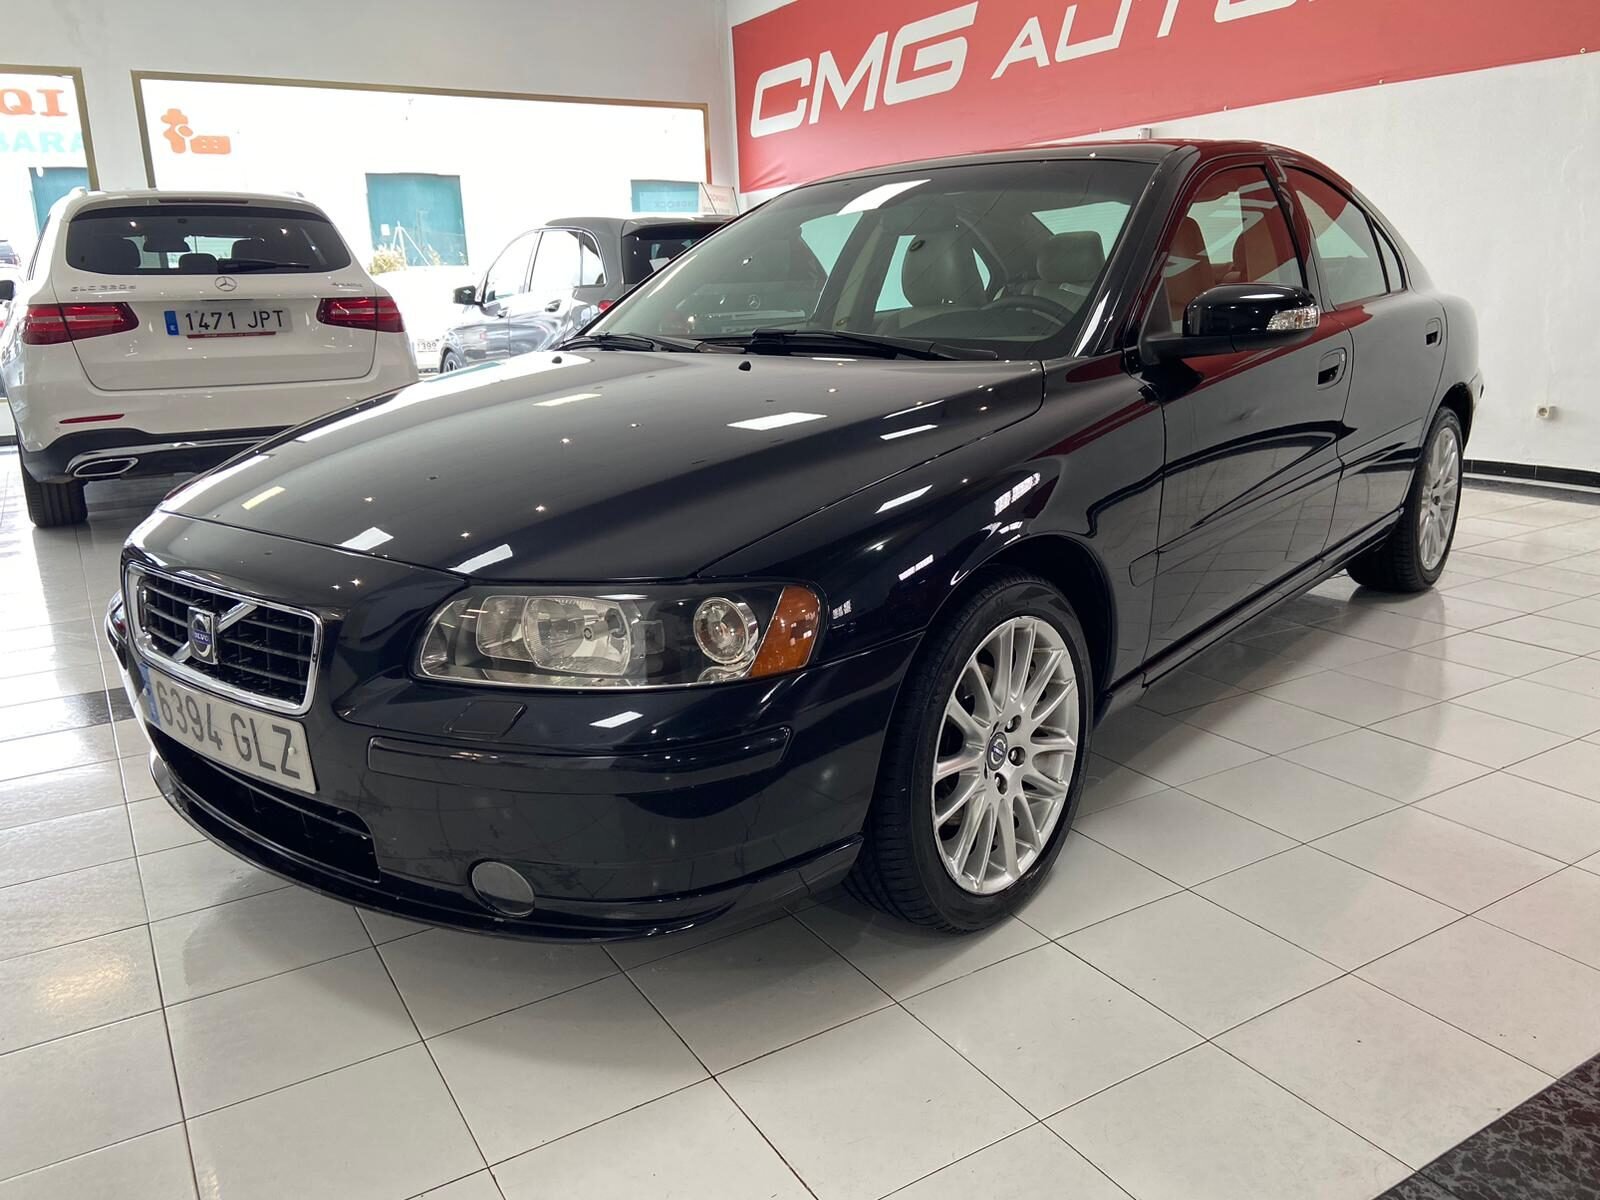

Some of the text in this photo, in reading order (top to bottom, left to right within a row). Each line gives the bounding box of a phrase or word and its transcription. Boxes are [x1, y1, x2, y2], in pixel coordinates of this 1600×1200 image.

[750, 1, 979, 138] CMG
[185, 309, 284, 331] 1471 JPT
[156, 680, 301, 780] 6394 GLZ
